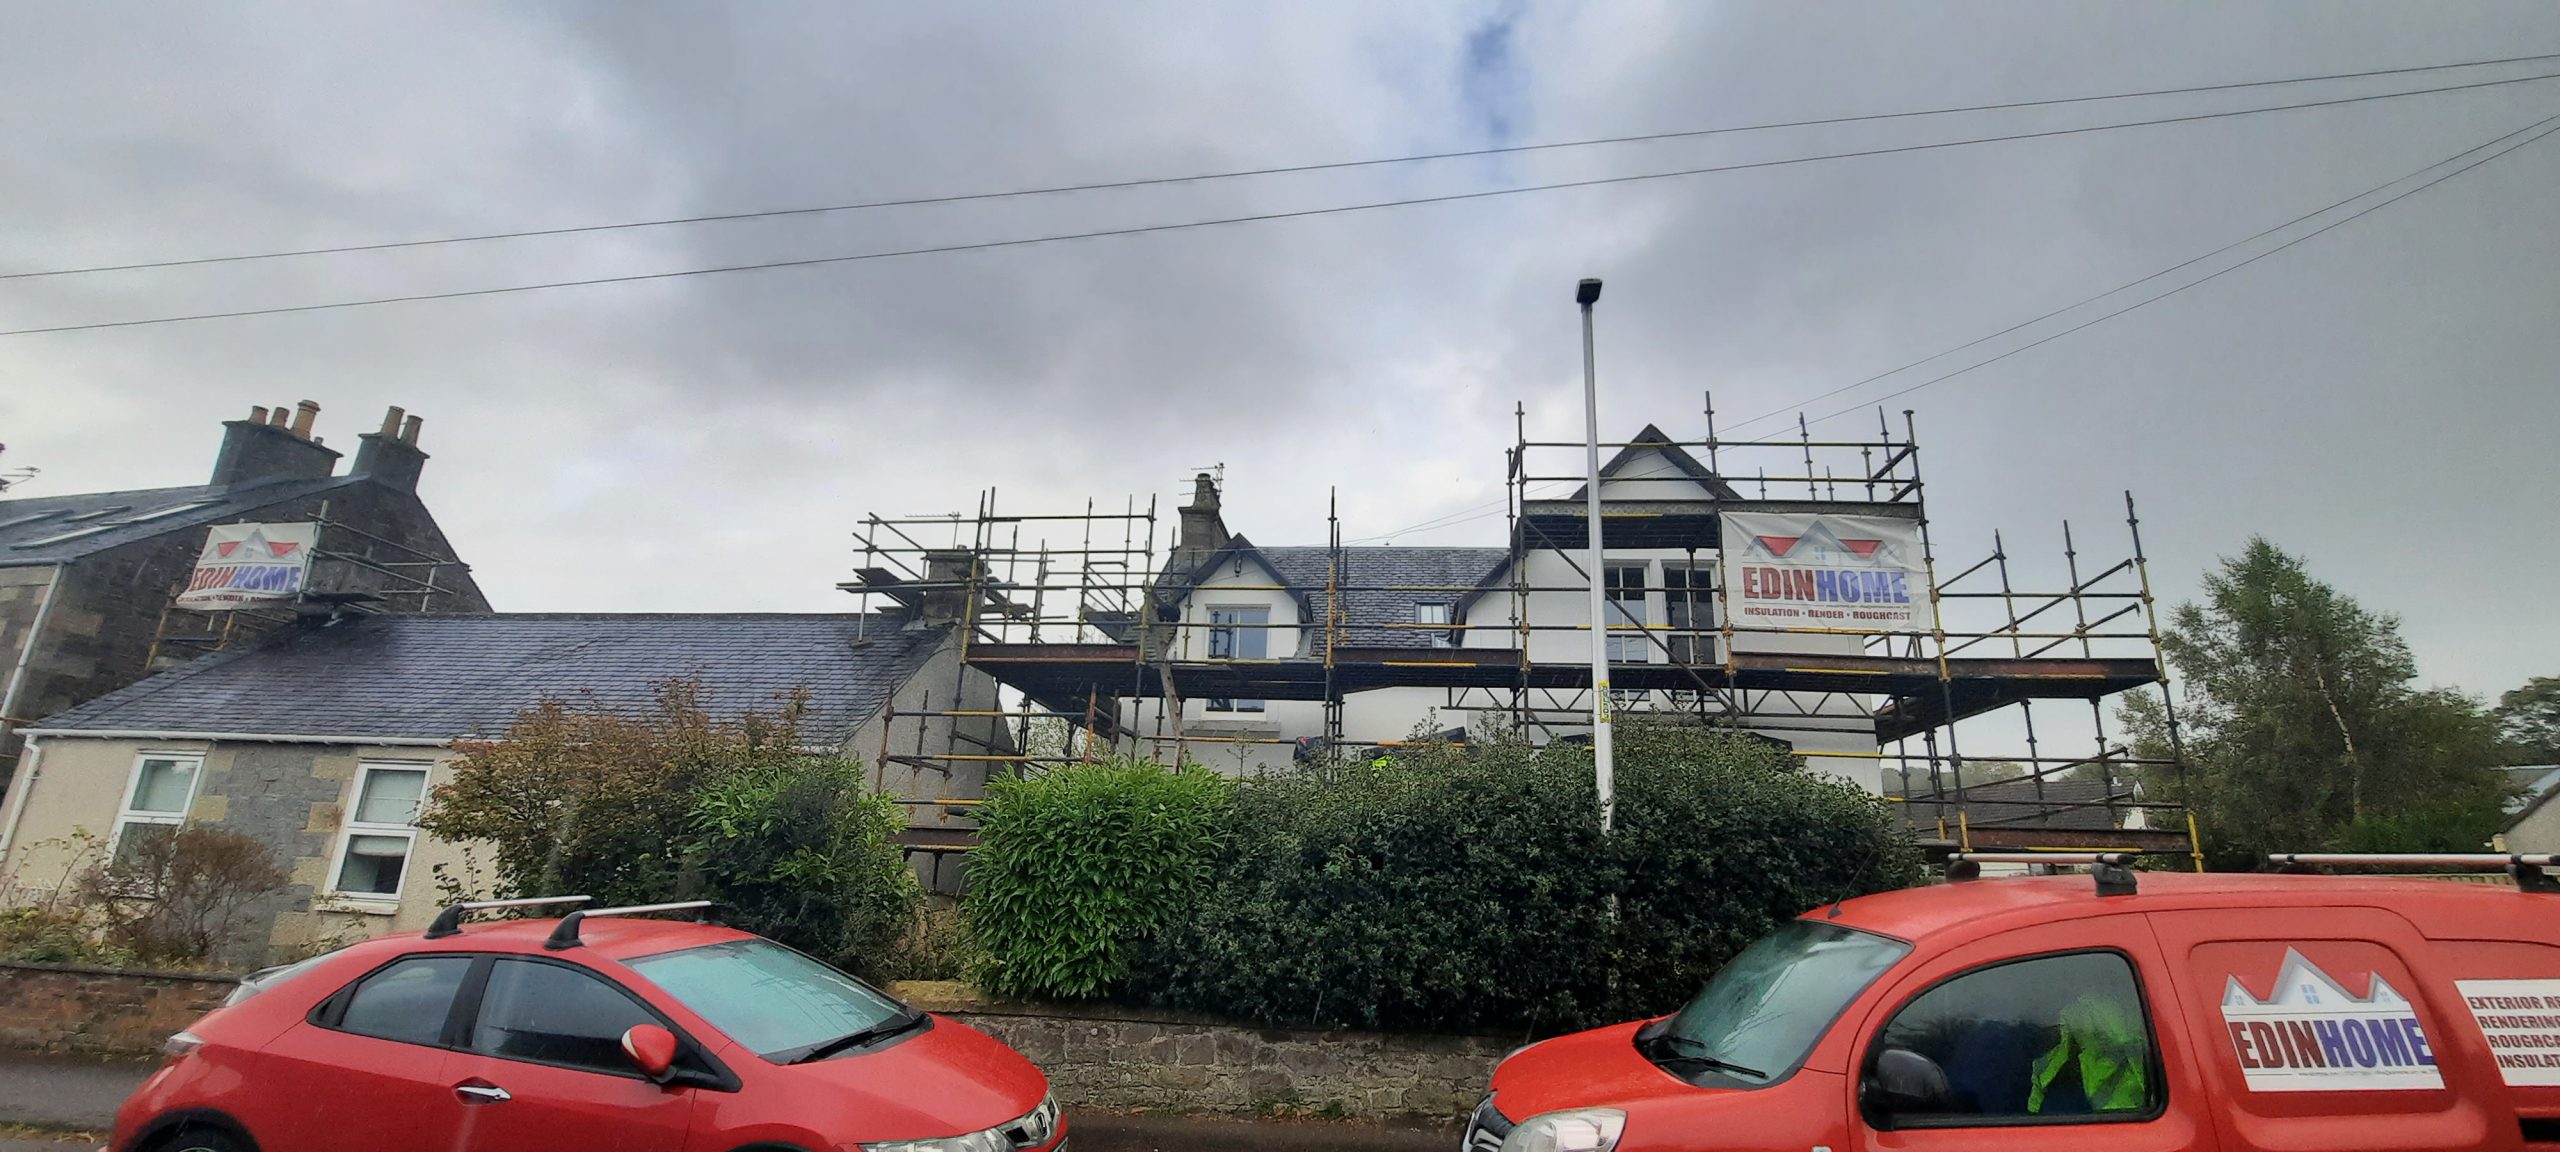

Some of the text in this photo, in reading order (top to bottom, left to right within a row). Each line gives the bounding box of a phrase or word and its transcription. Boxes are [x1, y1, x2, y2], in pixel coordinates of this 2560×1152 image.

[188, 566, 302, 592] EDINHOME
[1742, 567, 1910, 604] EDINHOME
[1744, 607, 1911, 621] INSULATION RENDER ROUGHCAST
[2467, 996, 2544, 1010] EXTERIOR
[2228, 1018, 2438, 1069] EDINHOME
